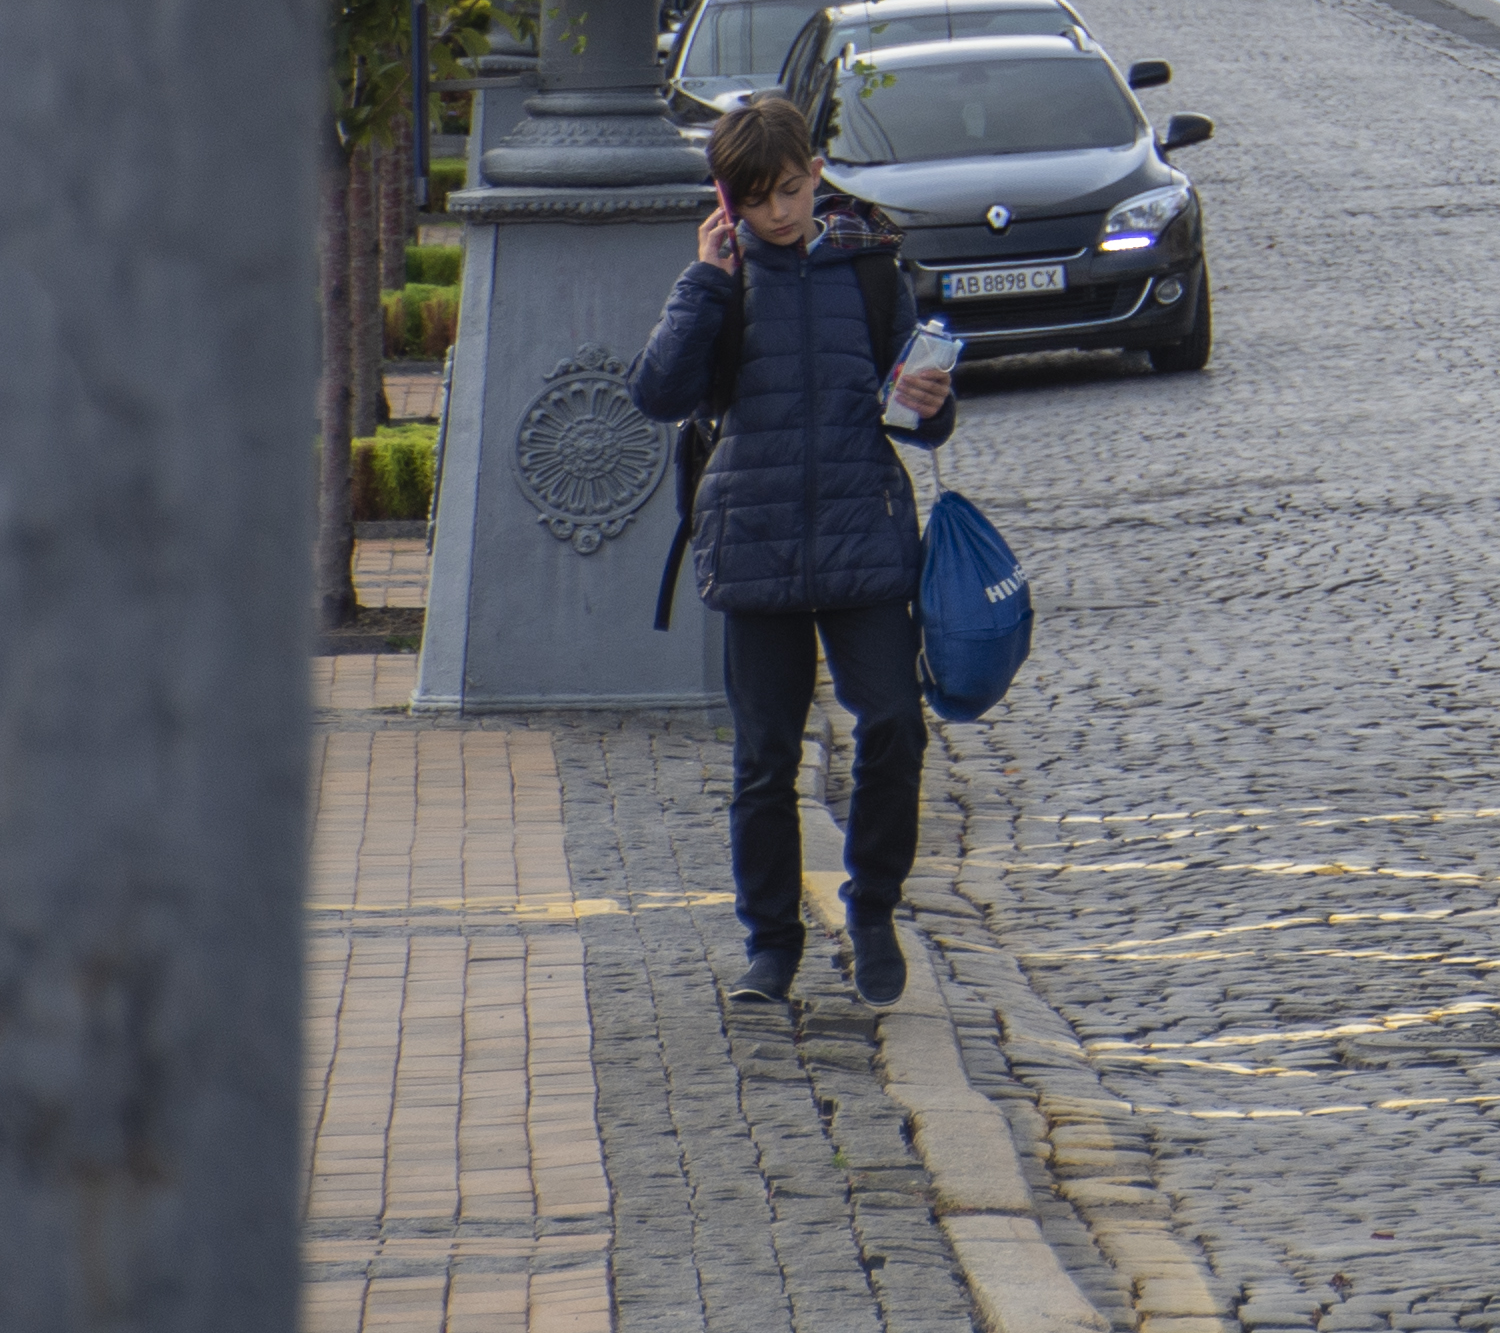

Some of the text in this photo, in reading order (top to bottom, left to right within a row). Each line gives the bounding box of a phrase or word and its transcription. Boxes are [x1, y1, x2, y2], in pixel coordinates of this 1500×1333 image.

[955, 269, 1058, 295] AB 8898 CX
